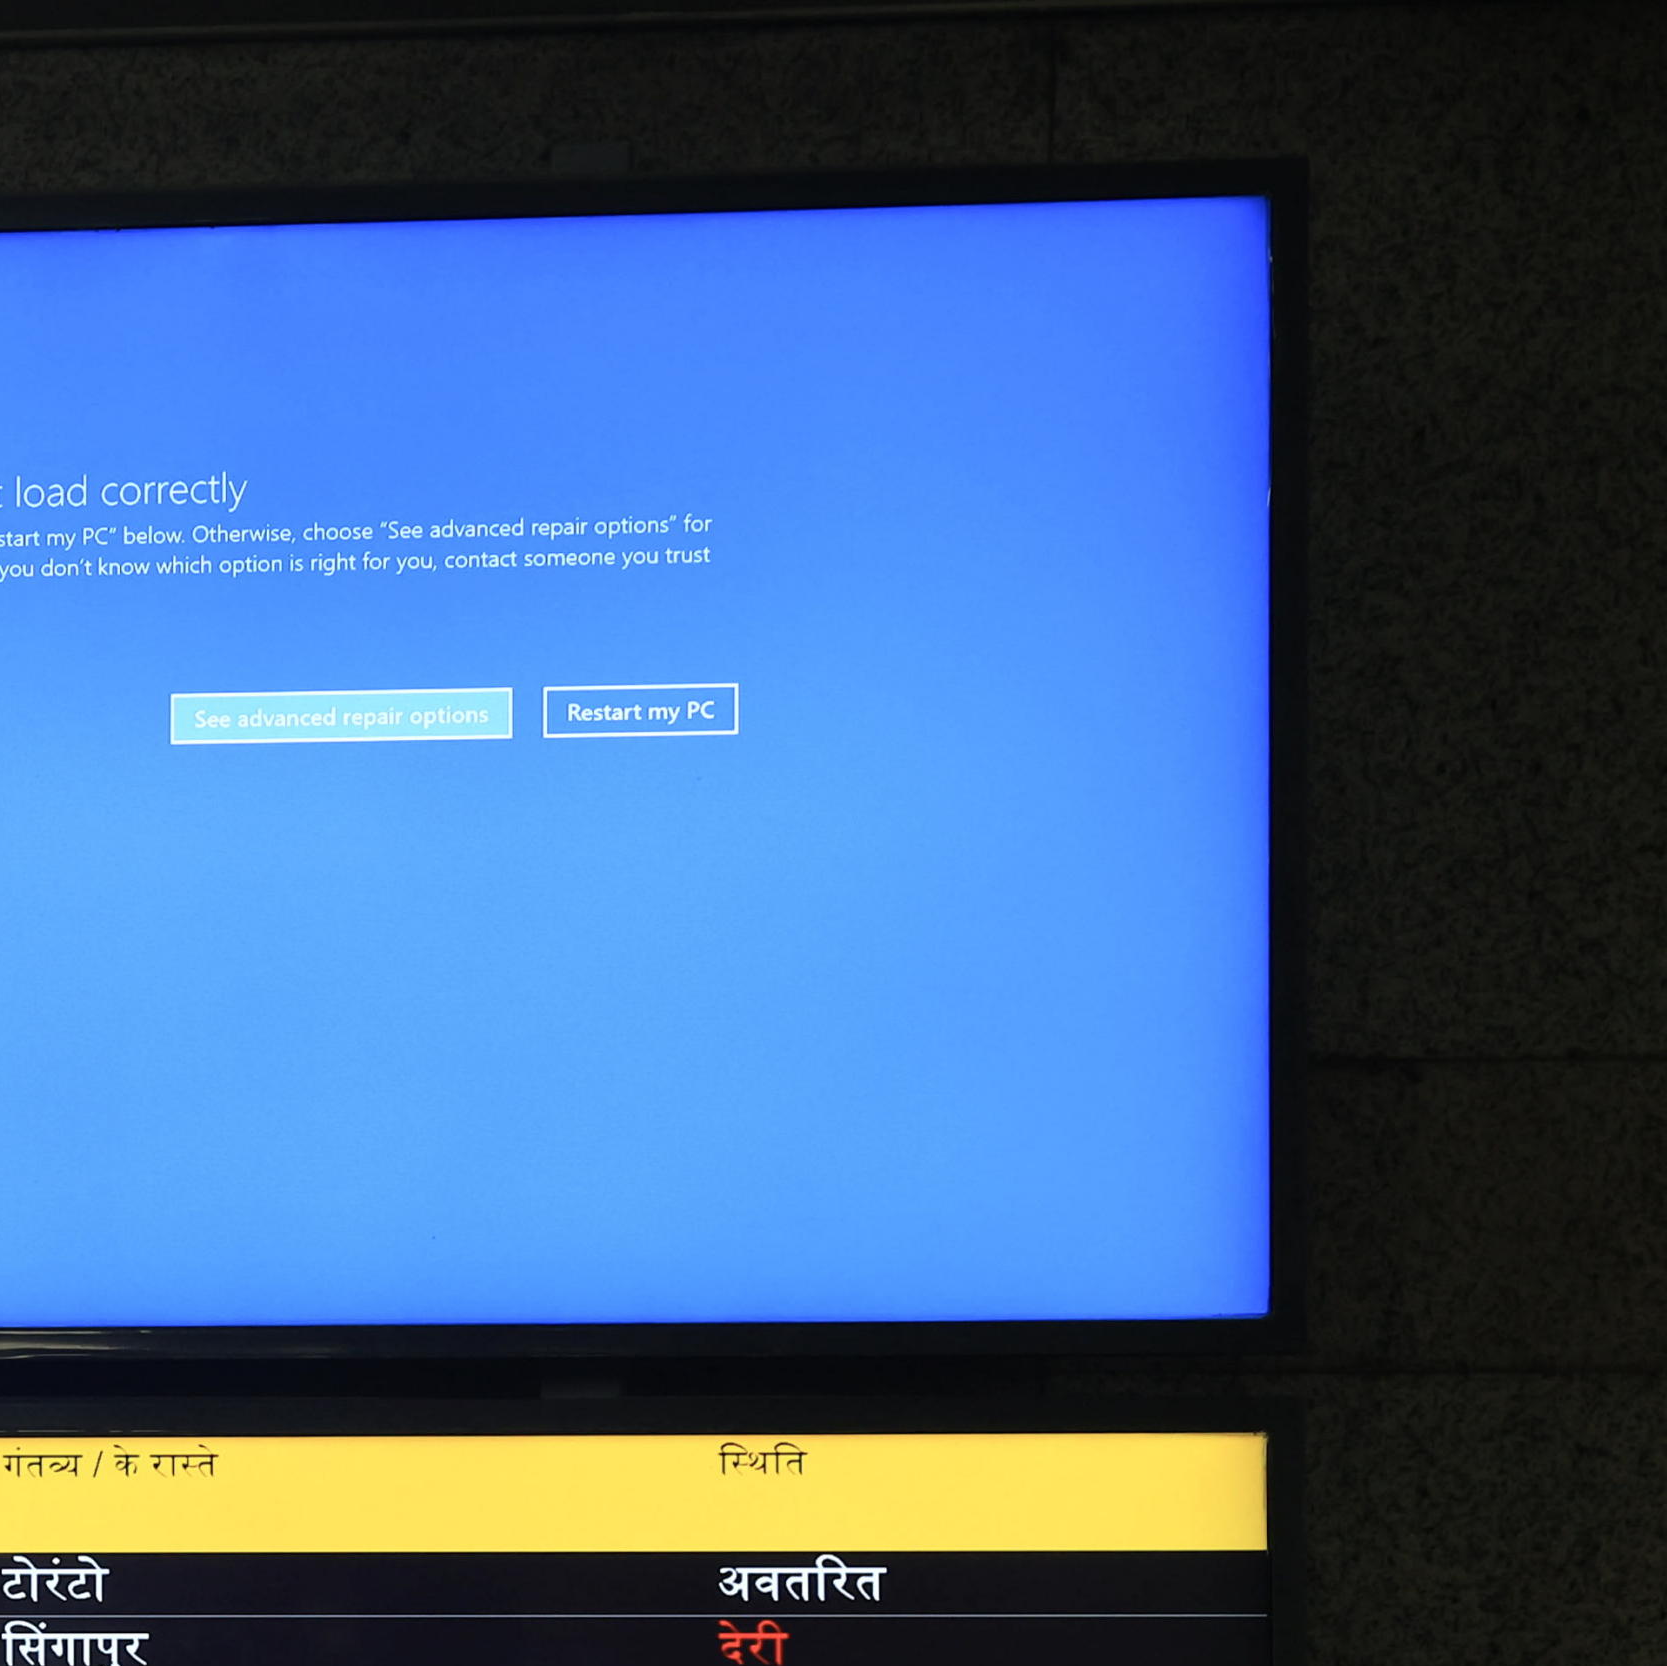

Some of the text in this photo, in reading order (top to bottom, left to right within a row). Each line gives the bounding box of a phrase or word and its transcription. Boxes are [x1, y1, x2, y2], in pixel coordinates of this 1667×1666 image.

[16, 473, 88, 508] load
[100, 470, 248, 513] correctly
[567, 700, 715, 725] Restart my PC
[2, 1454, 83, 1477] गंतव्य
[113, 1444, 140, 1477] के
[149, 1444, 219, 1477] रास्ते
[718, 1441, 808, 1475] स्थिति
[1, 1557, 110, 1603] टोरंटो
[718, 1557, 888, 1602] अवतरित
[718, 1619, 790, 1665] देरी
